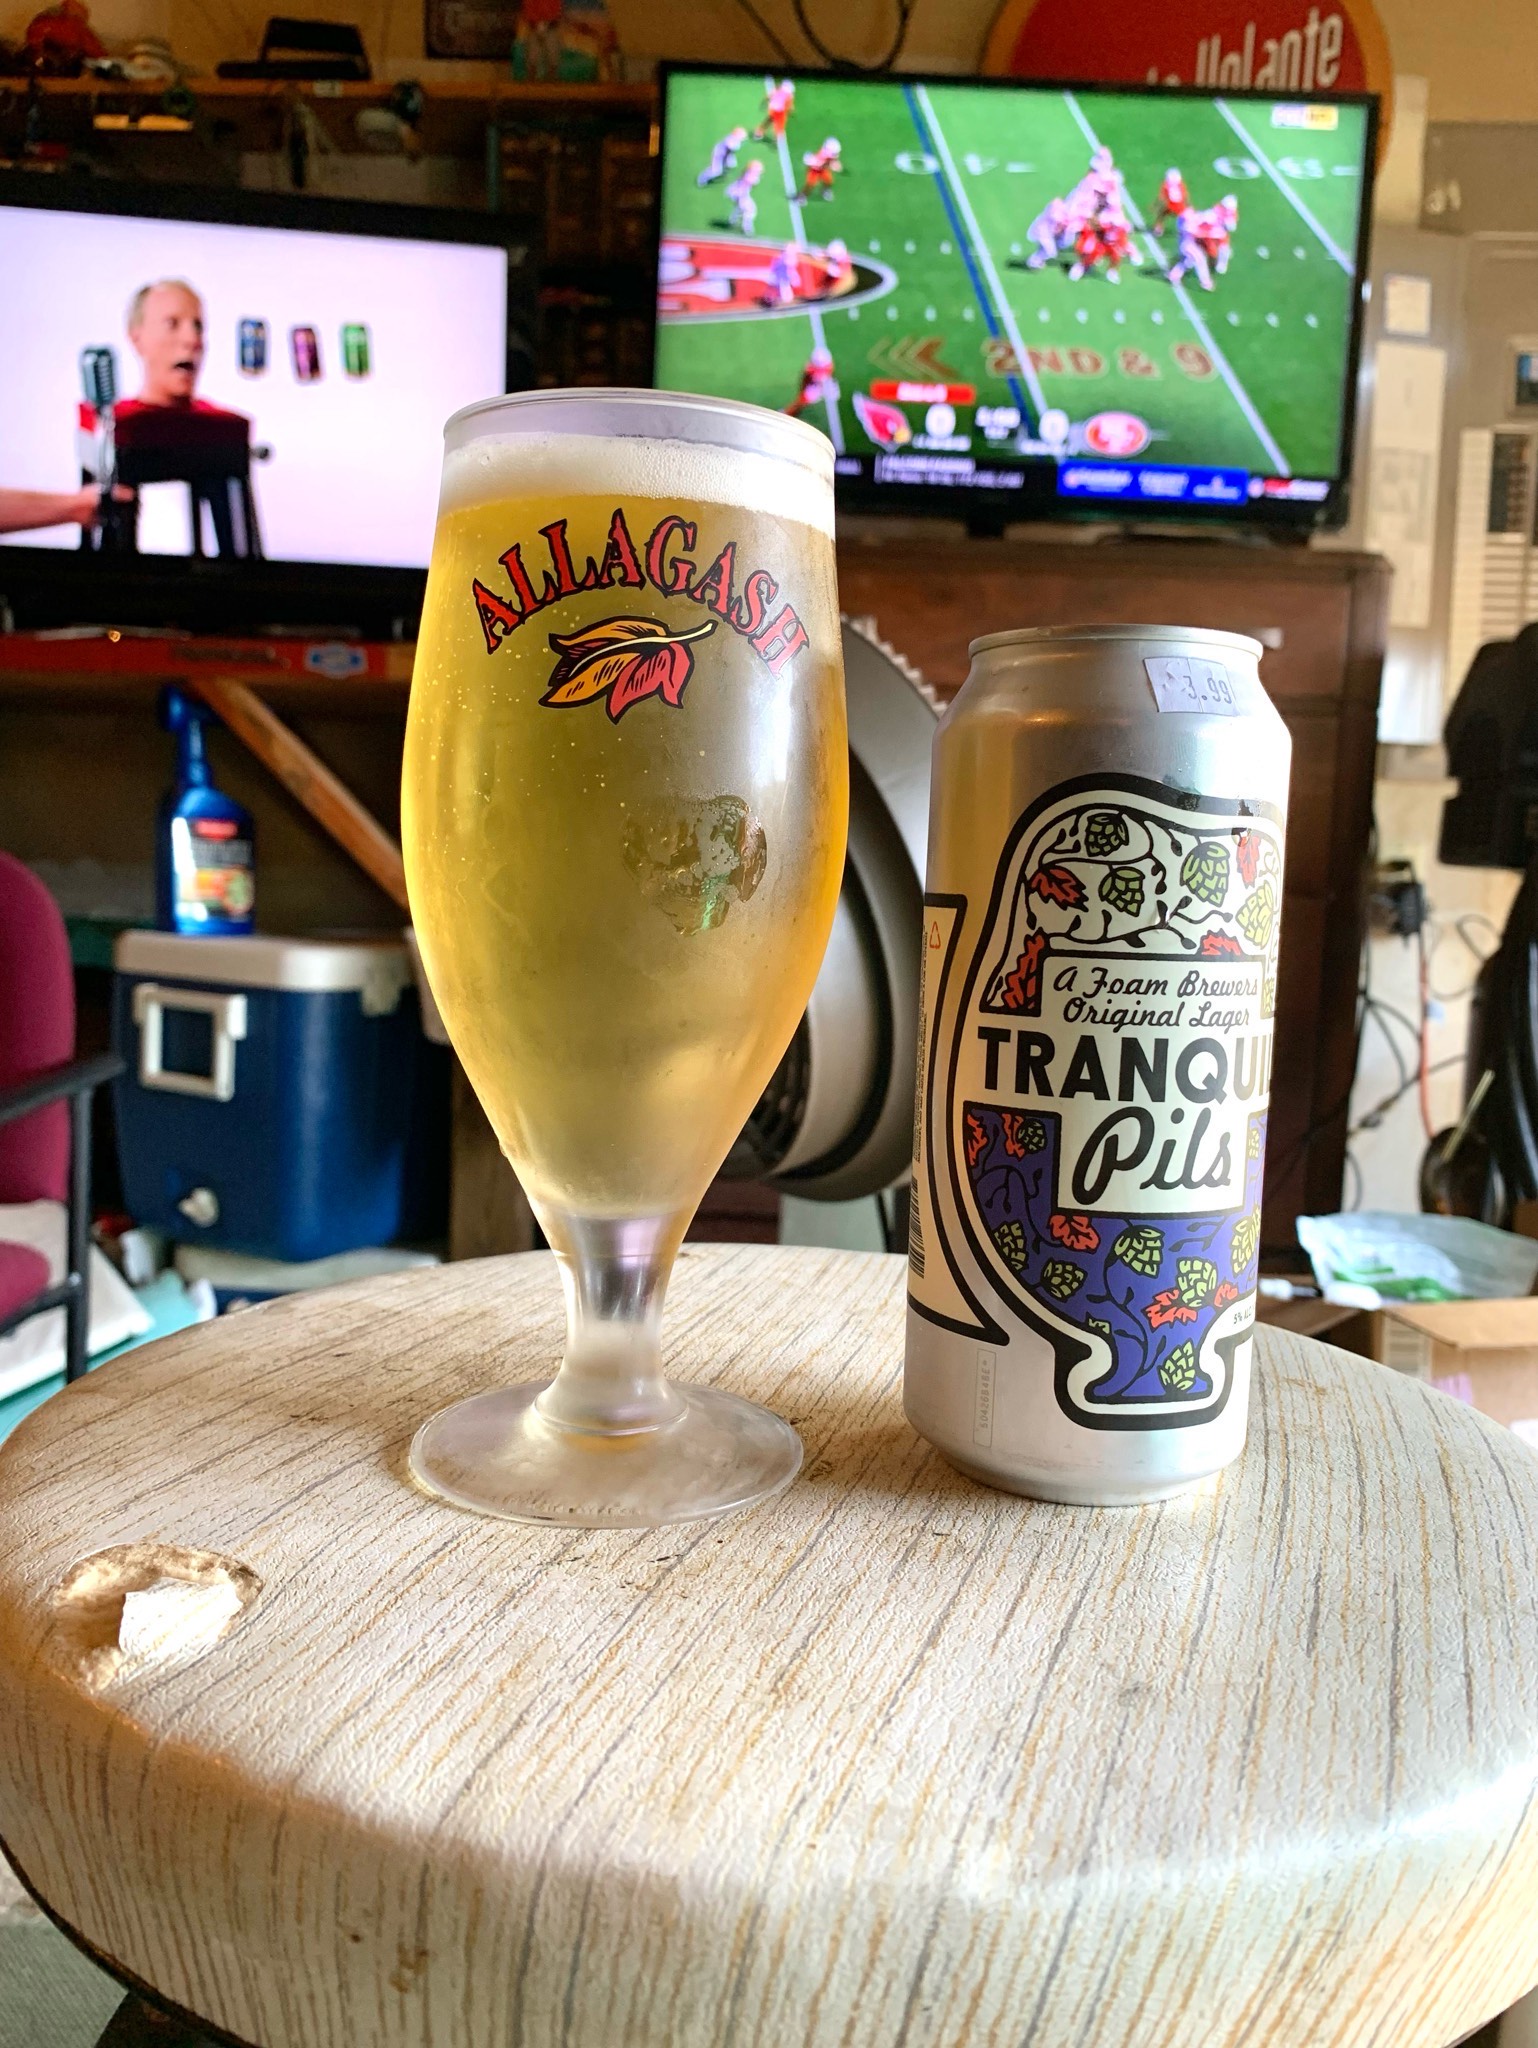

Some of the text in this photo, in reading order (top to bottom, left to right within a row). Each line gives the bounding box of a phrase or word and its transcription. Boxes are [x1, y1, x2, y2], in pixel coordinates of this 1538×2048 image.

[472, 508, 810, 680] ALLAGASH
[1053, 966, 1258, 999] A Foam Brewers
[1063, 996, 1251, 1034] Original Lager
[1071, 1105, 1232, 1206] Pils
